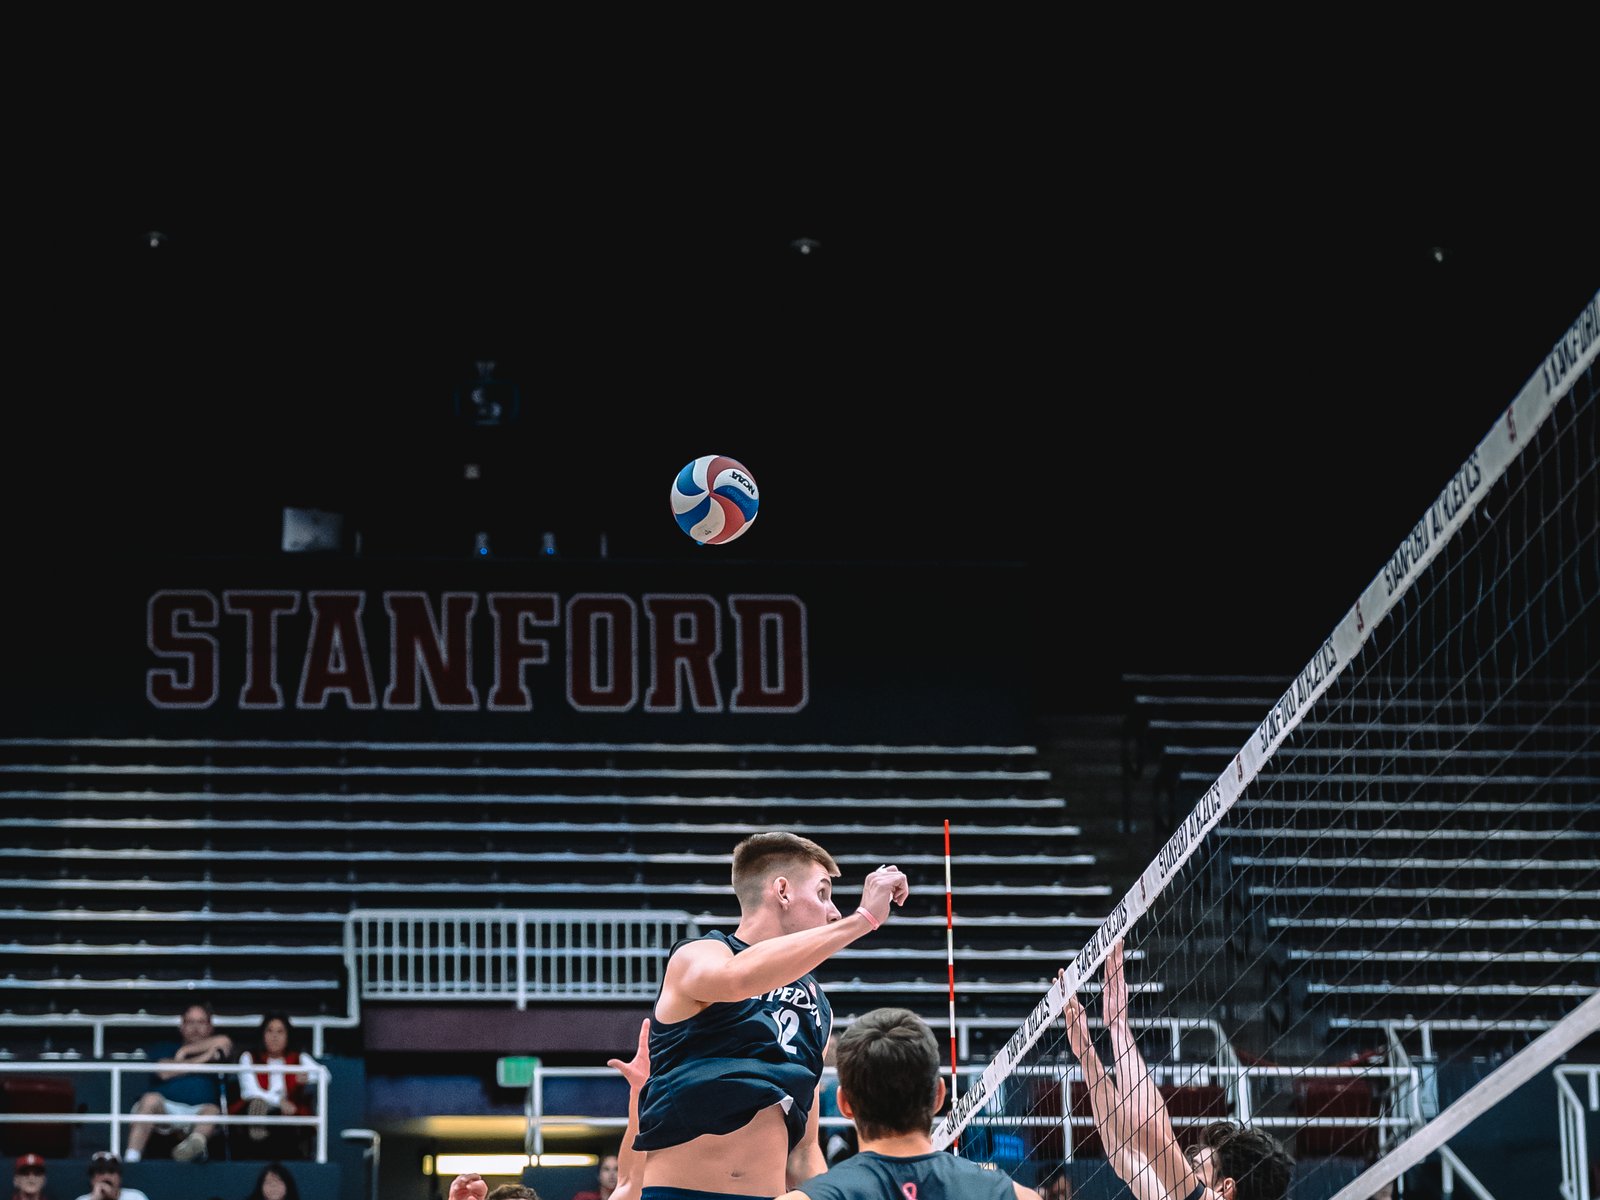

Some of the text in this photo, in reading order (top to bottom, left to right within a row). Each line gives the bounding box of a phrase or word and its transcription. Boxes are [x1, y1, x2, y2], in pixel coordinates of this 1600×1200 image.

[731, 471, 756, 496] NCAA
[146, 589, 809, 713] STANFORD
[771, 1007, 800, 1055] 12
